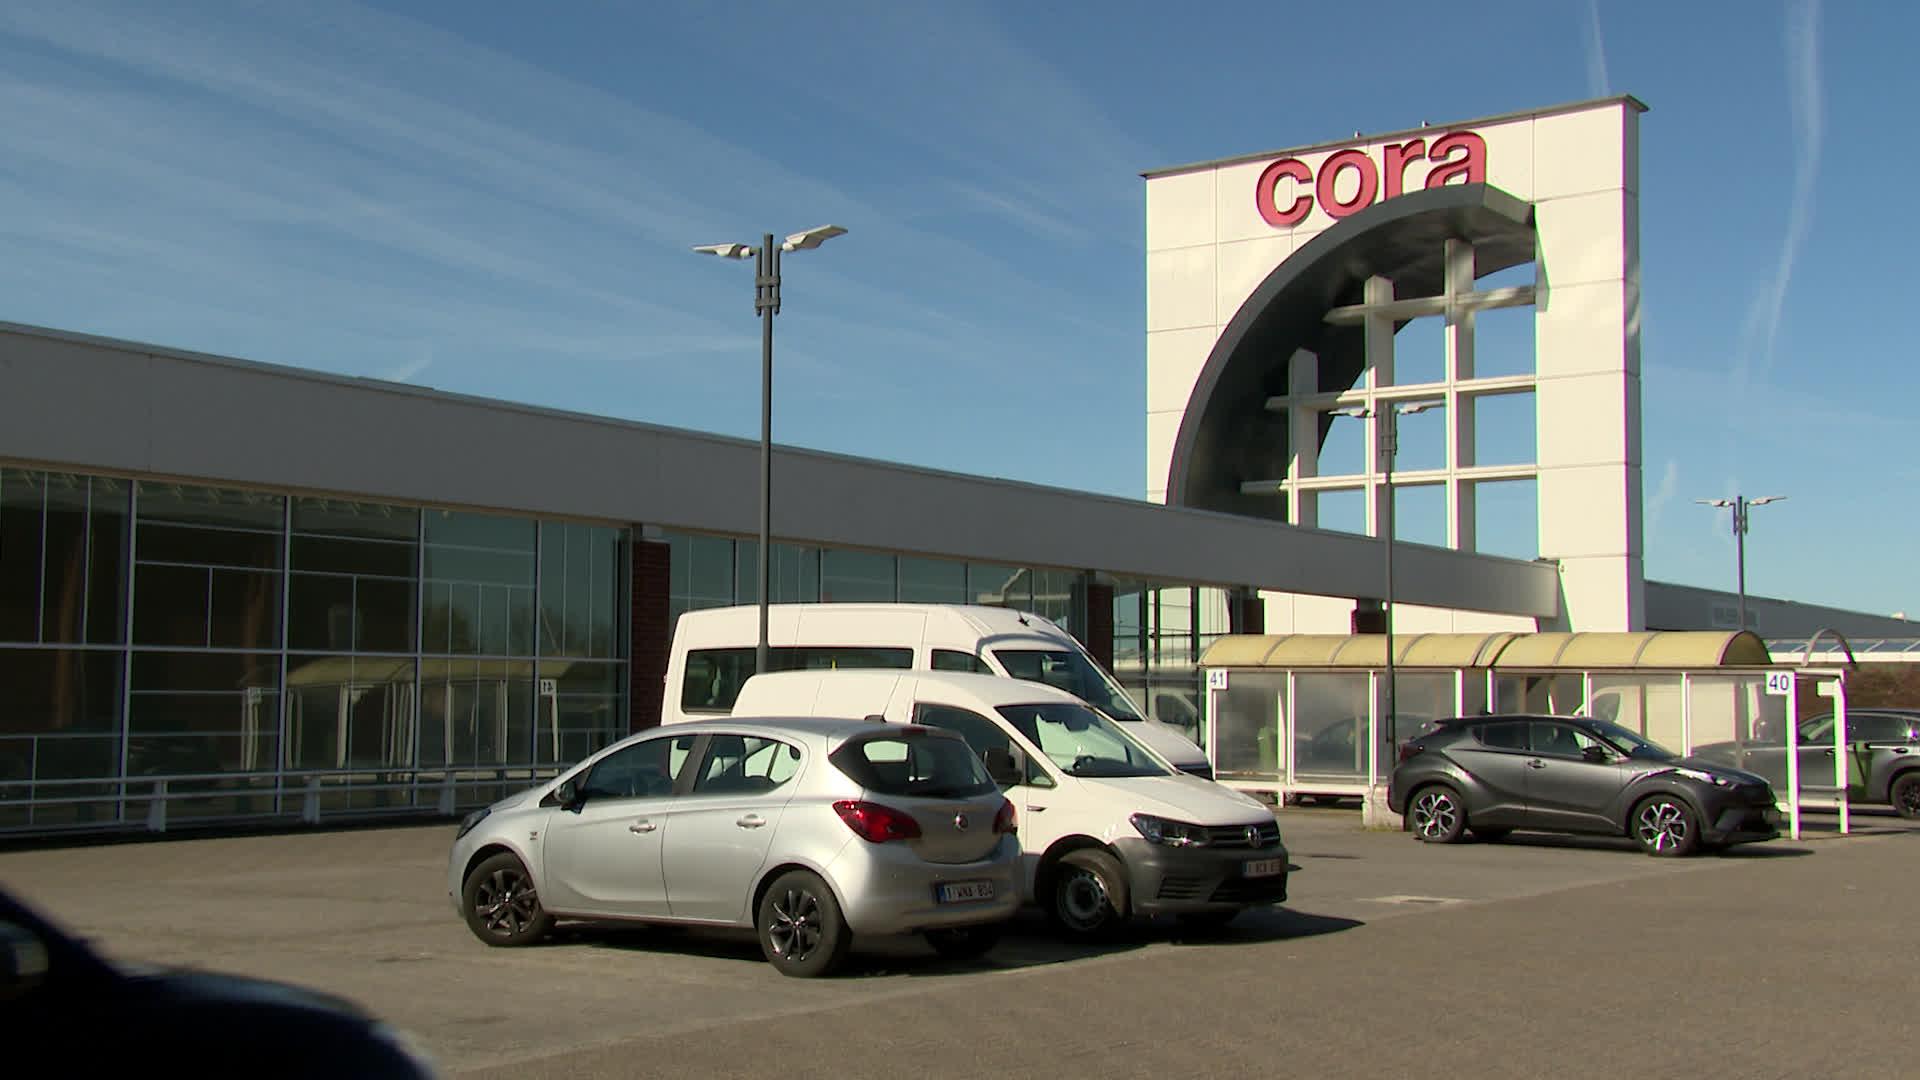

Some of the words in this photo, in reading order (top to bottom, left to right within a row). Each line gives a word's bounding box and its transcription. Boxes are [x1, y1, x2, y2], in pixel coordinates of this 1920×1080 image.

[1255, 130, 1487, 229] cora
[1210, 671, 1223, 686] 41
[1769, 674, 1789, 690] 40
